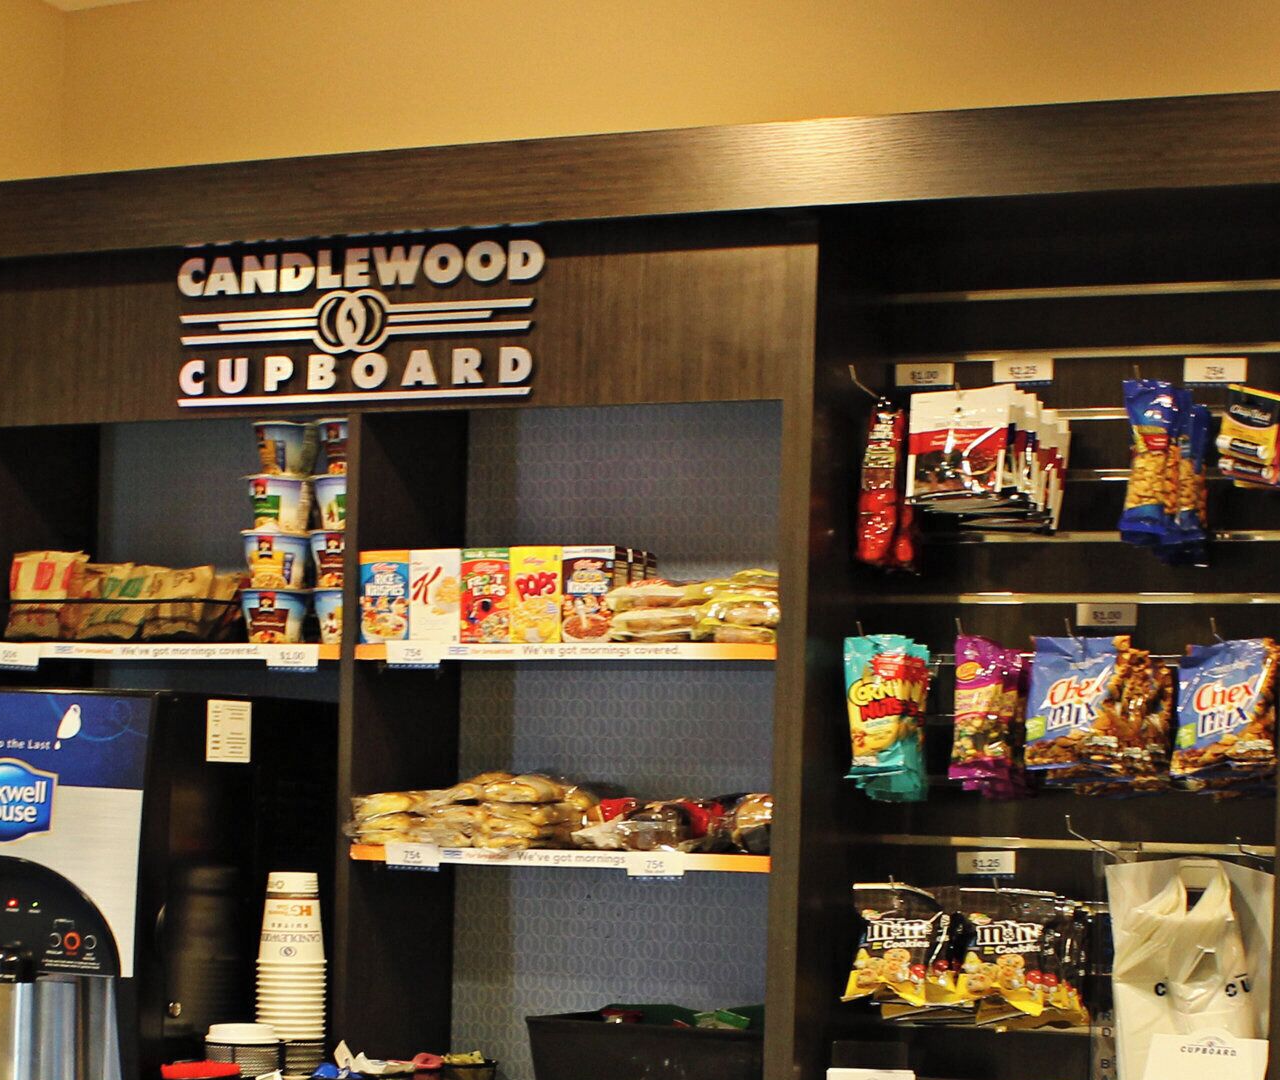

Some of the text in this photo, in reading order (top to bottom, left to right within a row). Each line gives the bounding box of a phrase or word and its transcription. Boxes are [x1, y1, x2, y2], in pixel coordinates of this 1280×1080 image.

[177, 240, 545, 298] CANDLEWOOD
[179, 346, 533, 396] CUPBOARD
[1048, 676, 1105, 706] Chex
[1194, 680, 1257, 713] Chex
[882, 939, 931, 950] Cookies
[1179, 1045, 1238, 1057] CUPBOARD
